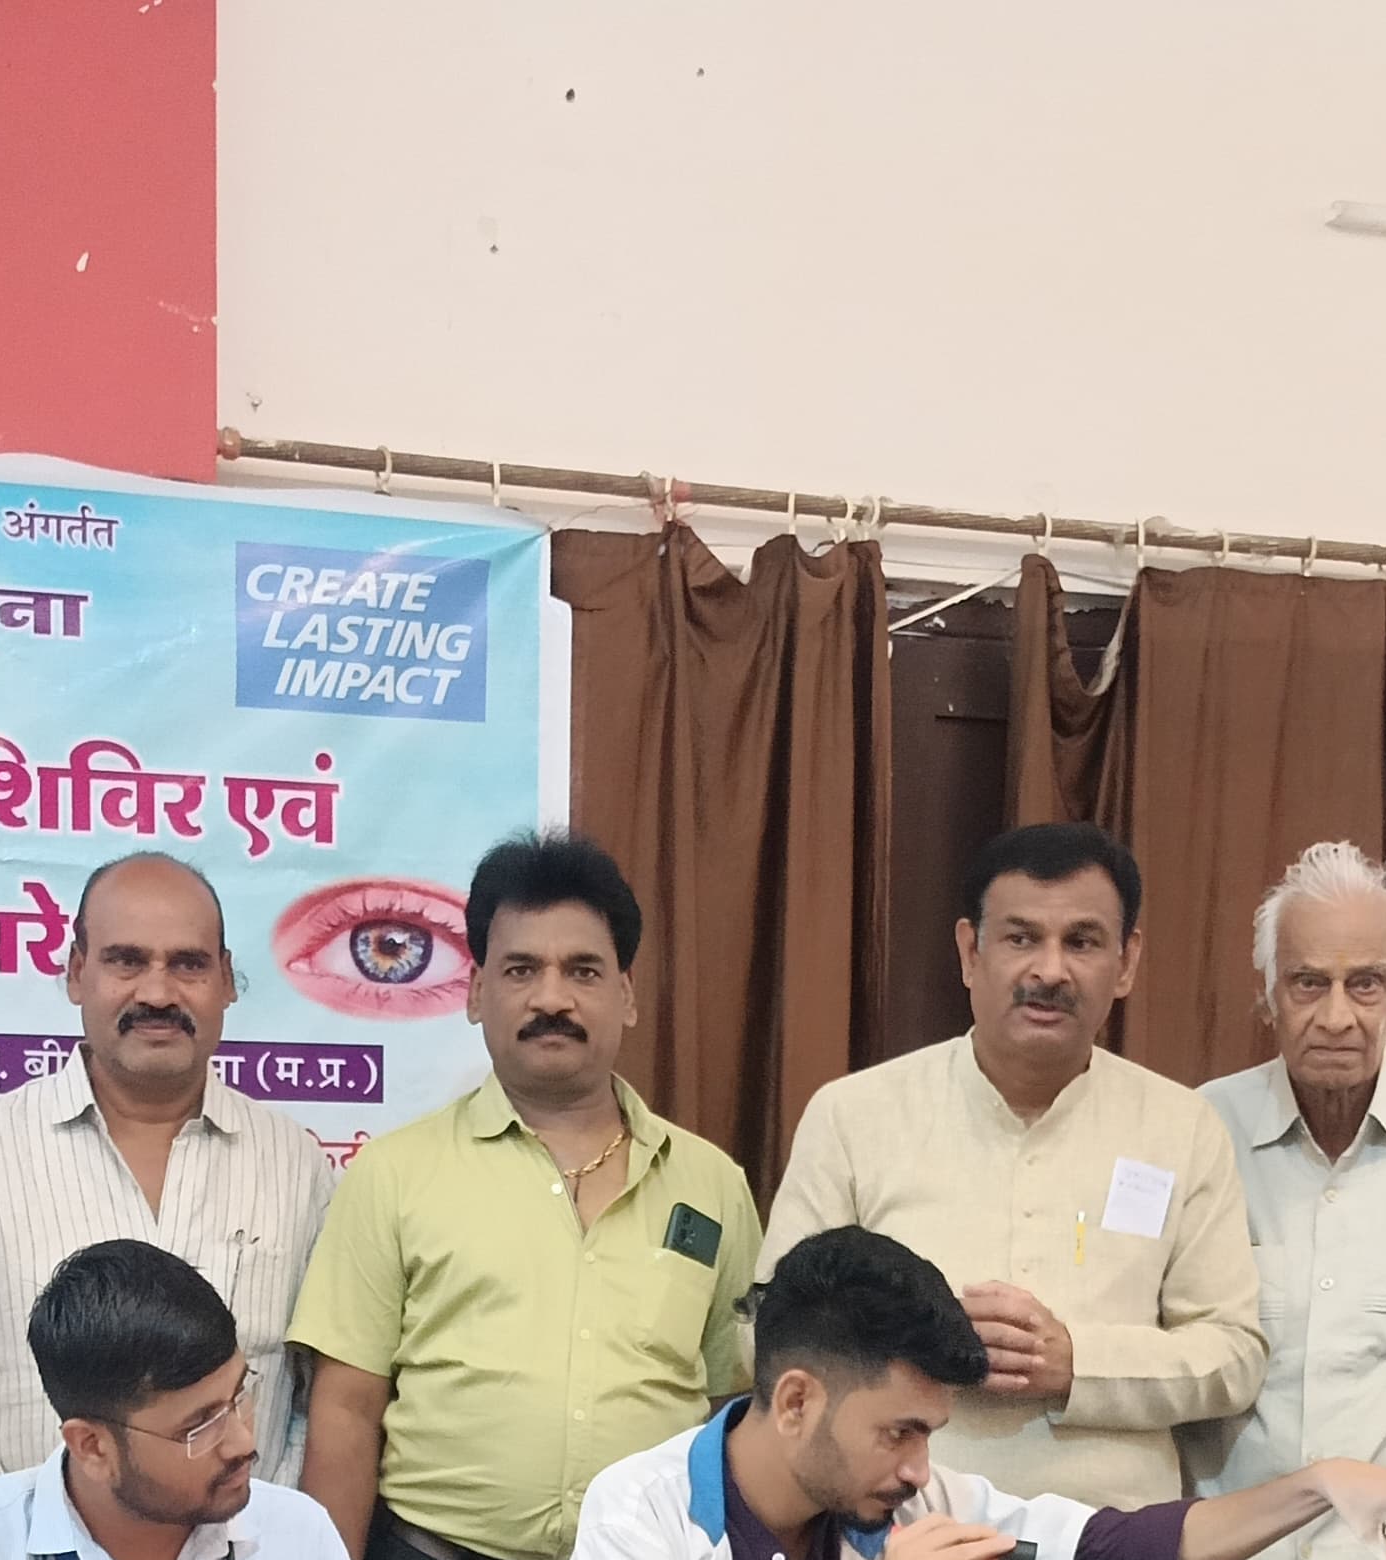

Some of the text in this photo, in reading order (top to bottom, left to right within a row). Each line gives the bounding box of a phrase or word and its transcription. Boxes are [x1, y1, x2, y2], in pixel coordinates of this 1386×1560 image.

[3, 502, 119, 549] अंगर्तत
[247, 563, 437, 612] CREATE
[262, 611, 473, 661] LASTING
[274, 657, 461, 706] IMPACT
[224, 753, 340, 858] एवं
